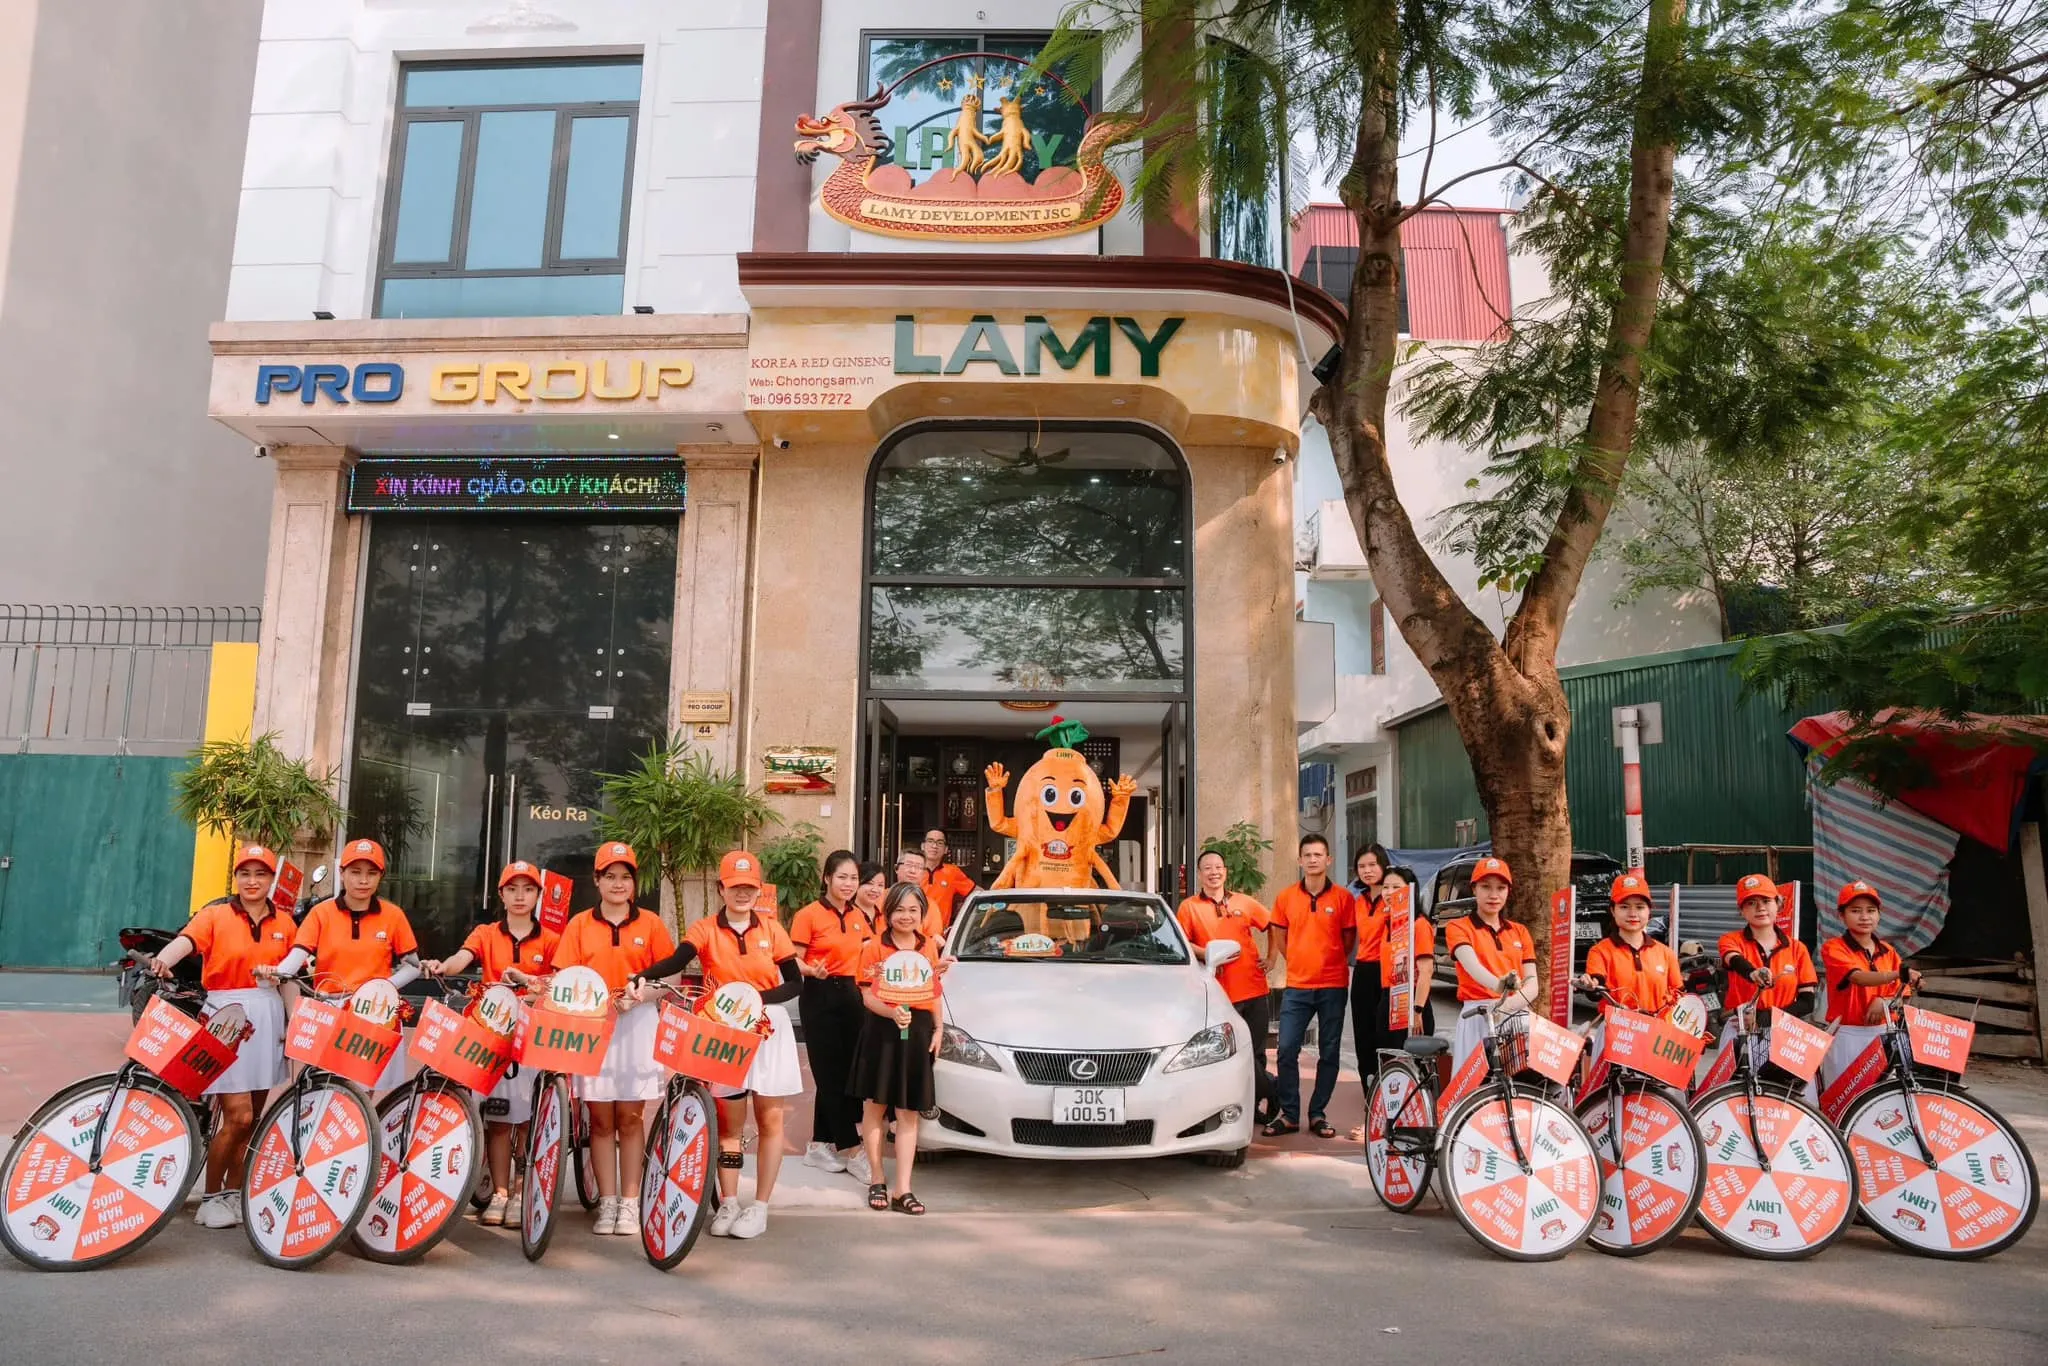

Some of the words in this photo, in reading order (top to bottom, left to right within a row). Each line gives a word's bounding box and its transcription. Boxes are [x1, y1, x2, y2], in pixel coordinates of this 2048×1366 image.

[869, 204, 916, 220] LAMY
[920, 210, 1041, 222] DEVELOPMENT
[1043, 207, 1071, 220] JSC
[894, 315, 1185, 377] LAMY
[751, 358, 797, 368] KOREA
[801, 358, 829, 368] RED
[832, 357, 891, 368] GINSENG
[255, 363, 405, 404] PRO
[430, 359, 694, 402] GROUP
[750, 377, 773, 387] Web:
[776, 376, 874, 388] Chohongsam.vn
[749, 394, 765, 405] Tel:
[375, 478, 407, 495] XIN
[698, 726, 711, 734] 44
[770, 759, 828, 771] LAMY
[530, 805, 562, 820] Kéo
[565, 807, 588, 821] Ra
[334, 1028, 390, 1064] LAMY
[534, 1026, 600, 1053] LAMY
[692, 1034, 751, 1066] LAMY
[1653, 1035, 1696, 1068] LAMY
[182, 1044, 224, 1080] LAMY
[454, 1036, 508, 1073] LAMY
[1074, 1089, 1104, 1105] 30K
[1063, 1107, 1116, 1122] 100.51
[1536, 1134, 1565, 1161] LAMY
[1717, 1130, 1742, 1162] LAMY
[1788, 1139, 1815, 1173] LAMY
[131, 1152, 155, 1189] LAMY
[430, 1145, 443, 1180] LAMY
[1484, 1147, 1499, 1181] LAMY
[1650, 1144, 1664, 1177] LAMY
[1965, 1152, 1986, 1187] LAMY
[322, 1159, 343, 1197] LAMY
[48, 1192, 82, 1220] LAMY
[269, 1187, 289, 1217] LAMY
[375, 1195, 399, 1218] LAMY
[1531, 1198, 1560, 1221] LAMY
[1745, 1200, 1782, 1214] LAMY
[1898, 1188, 1938, 1214] LAMY
